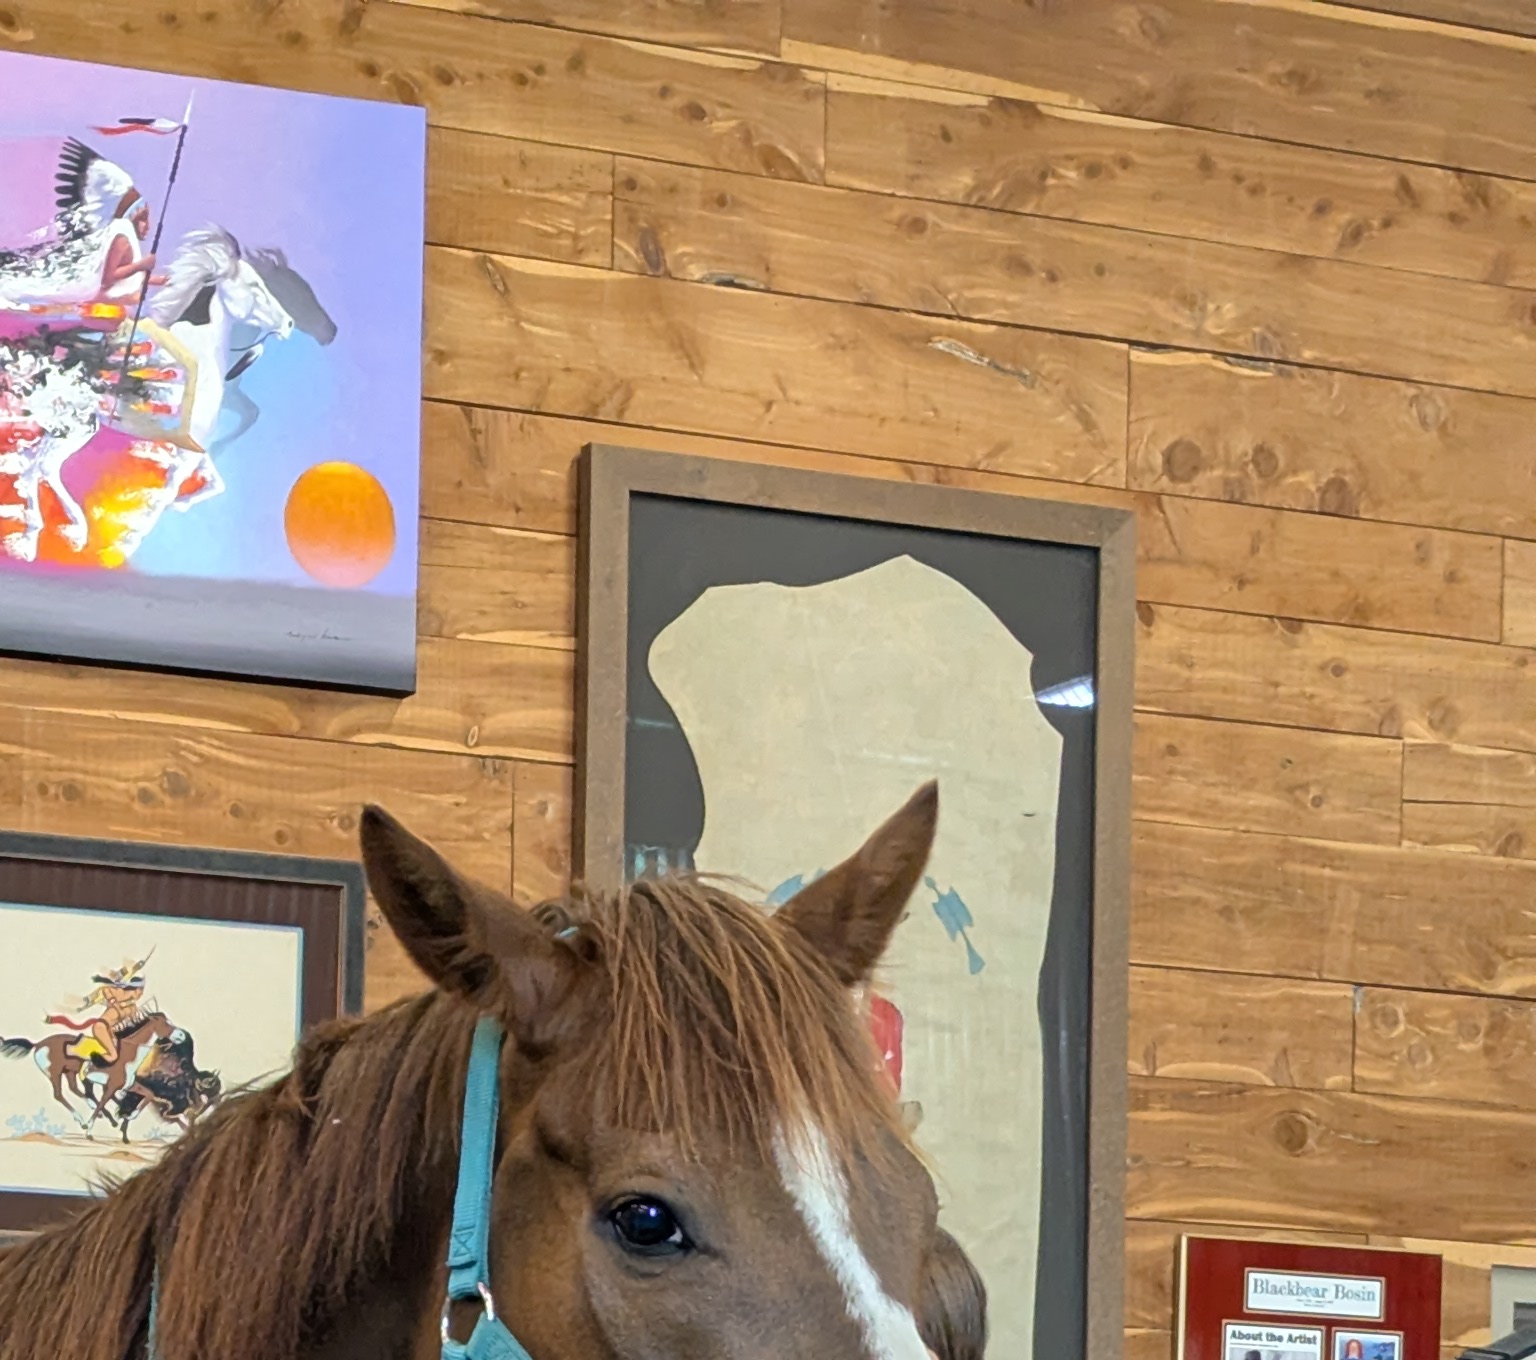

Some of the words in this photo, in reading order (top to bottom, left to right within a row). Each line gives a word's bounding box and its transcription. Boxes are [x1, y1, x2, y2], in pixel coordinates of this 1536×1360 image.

[1252, 1277, 1328, 1299] Blackbear
[1333, 1283, 1376, 1303] Bosin
[1229, 1330, 1263, 1342] About
[1265, 1331, 1284, 1343] the
[1286, 1333, 1318, 1346] Artist
